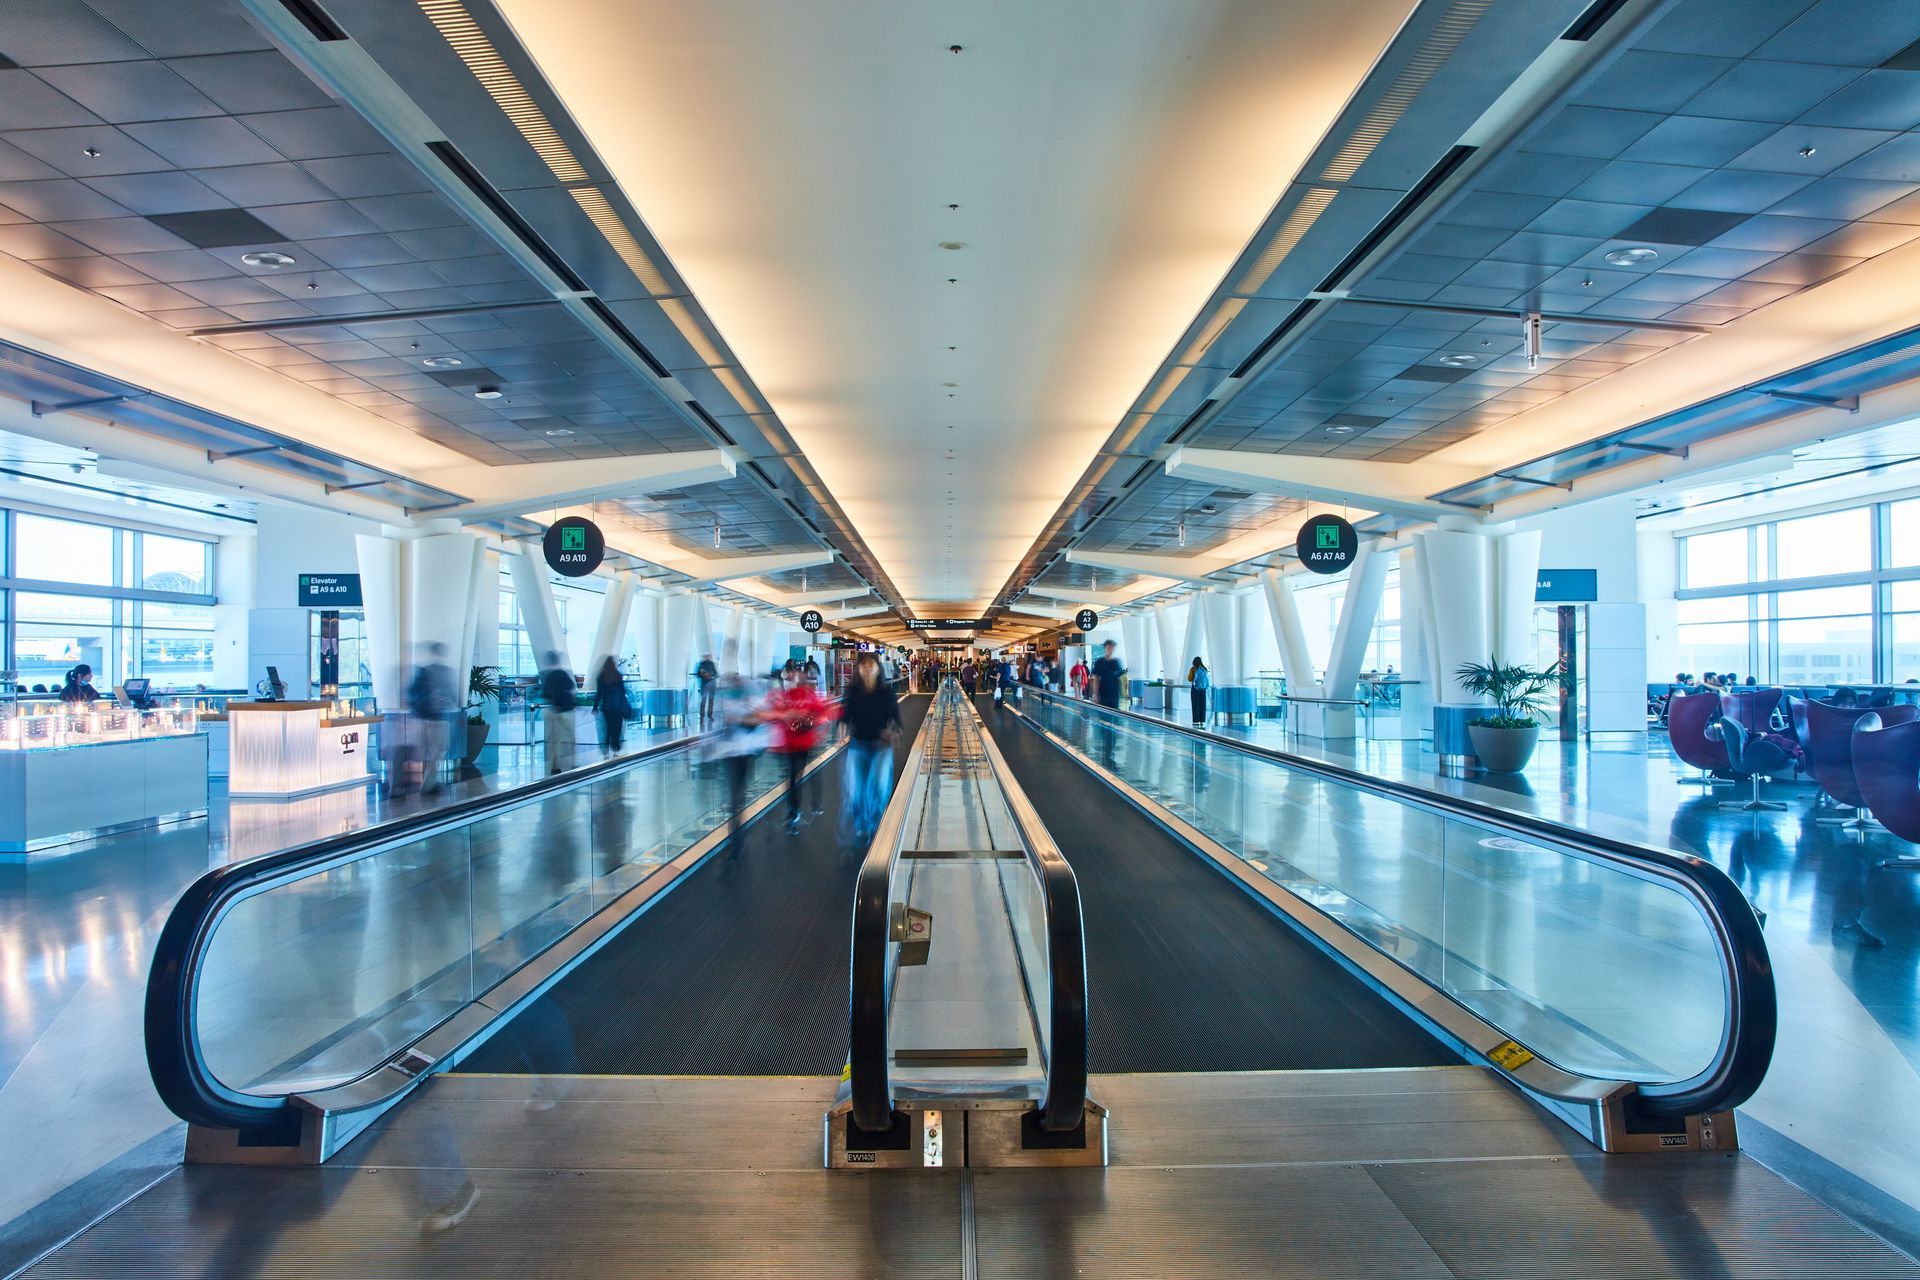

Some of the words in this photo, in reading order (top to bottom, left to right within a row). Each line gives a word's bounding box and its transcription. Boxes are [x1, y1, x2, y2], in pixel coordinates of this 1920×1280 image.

[560, 554, 571, 562] A9
[572, 554, 587, 562] A10
[1311, 552, 1321, 560] A6
[1323, 552, 1333, 560] A7
[1334, 552, 1345, 560] A8
[806, 613, 817, 621] A9
